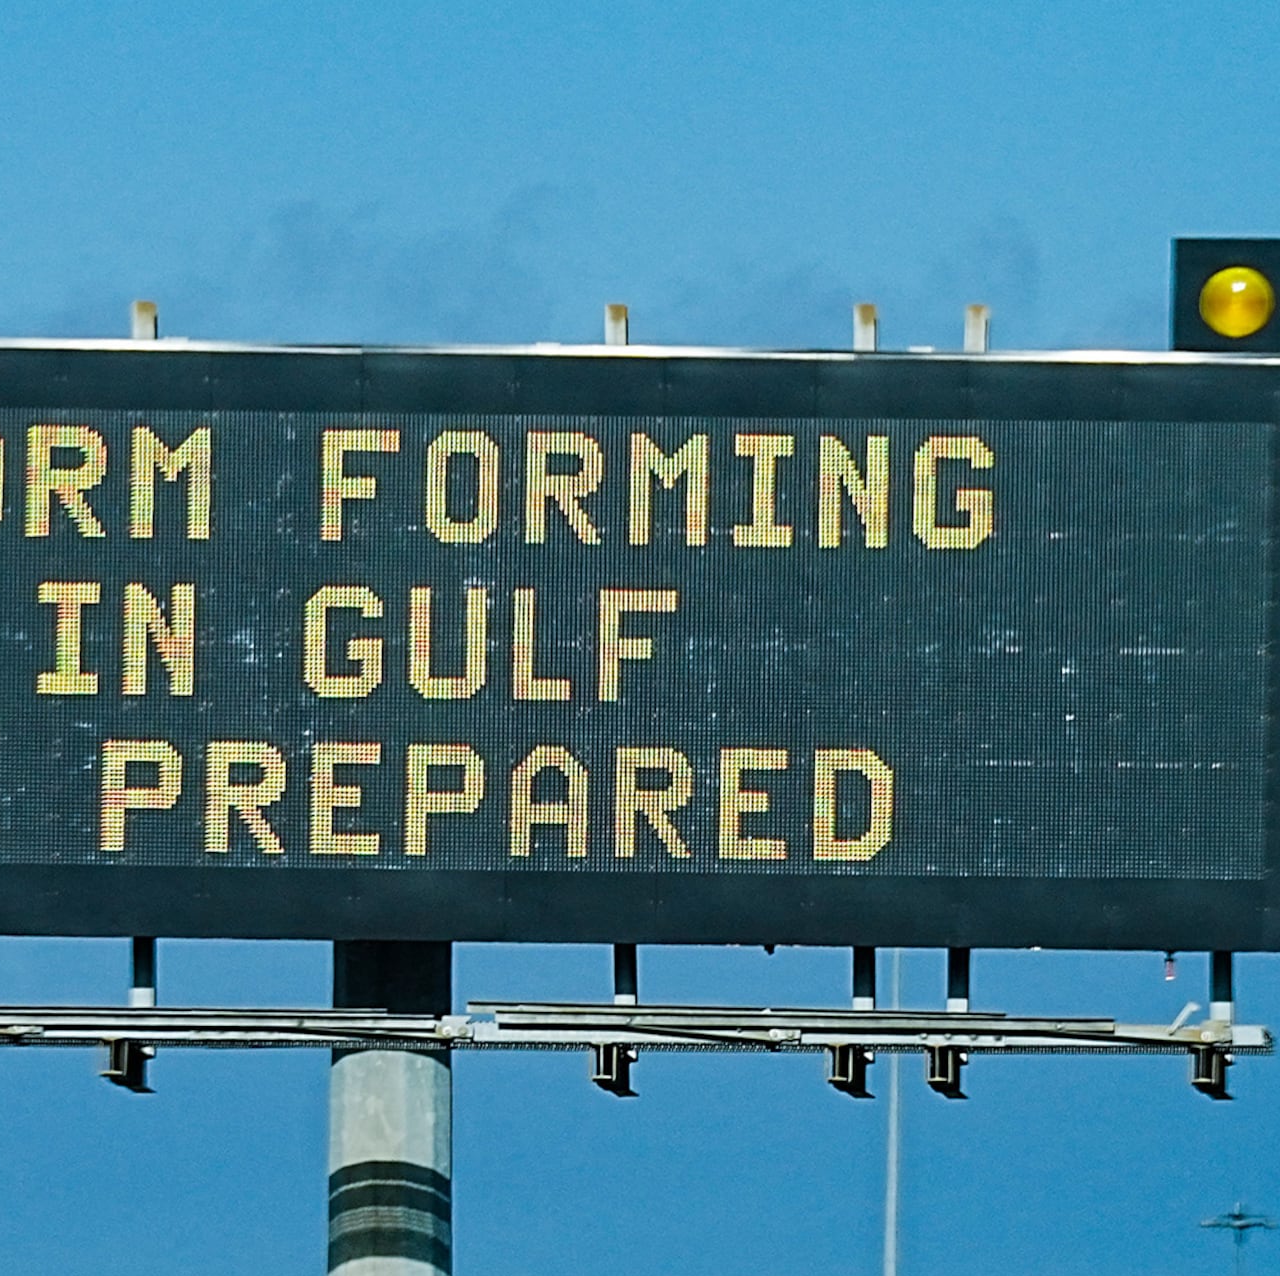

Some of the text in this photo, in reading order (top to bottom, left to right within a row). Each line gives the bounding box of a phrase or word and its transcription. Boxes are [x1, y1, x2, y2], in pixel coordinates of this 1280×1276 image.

[319, 428, 995, 550] FORMING
[36, 581, 679, 702] IN GULF
[99, 739, 895, 863] PREPARED
